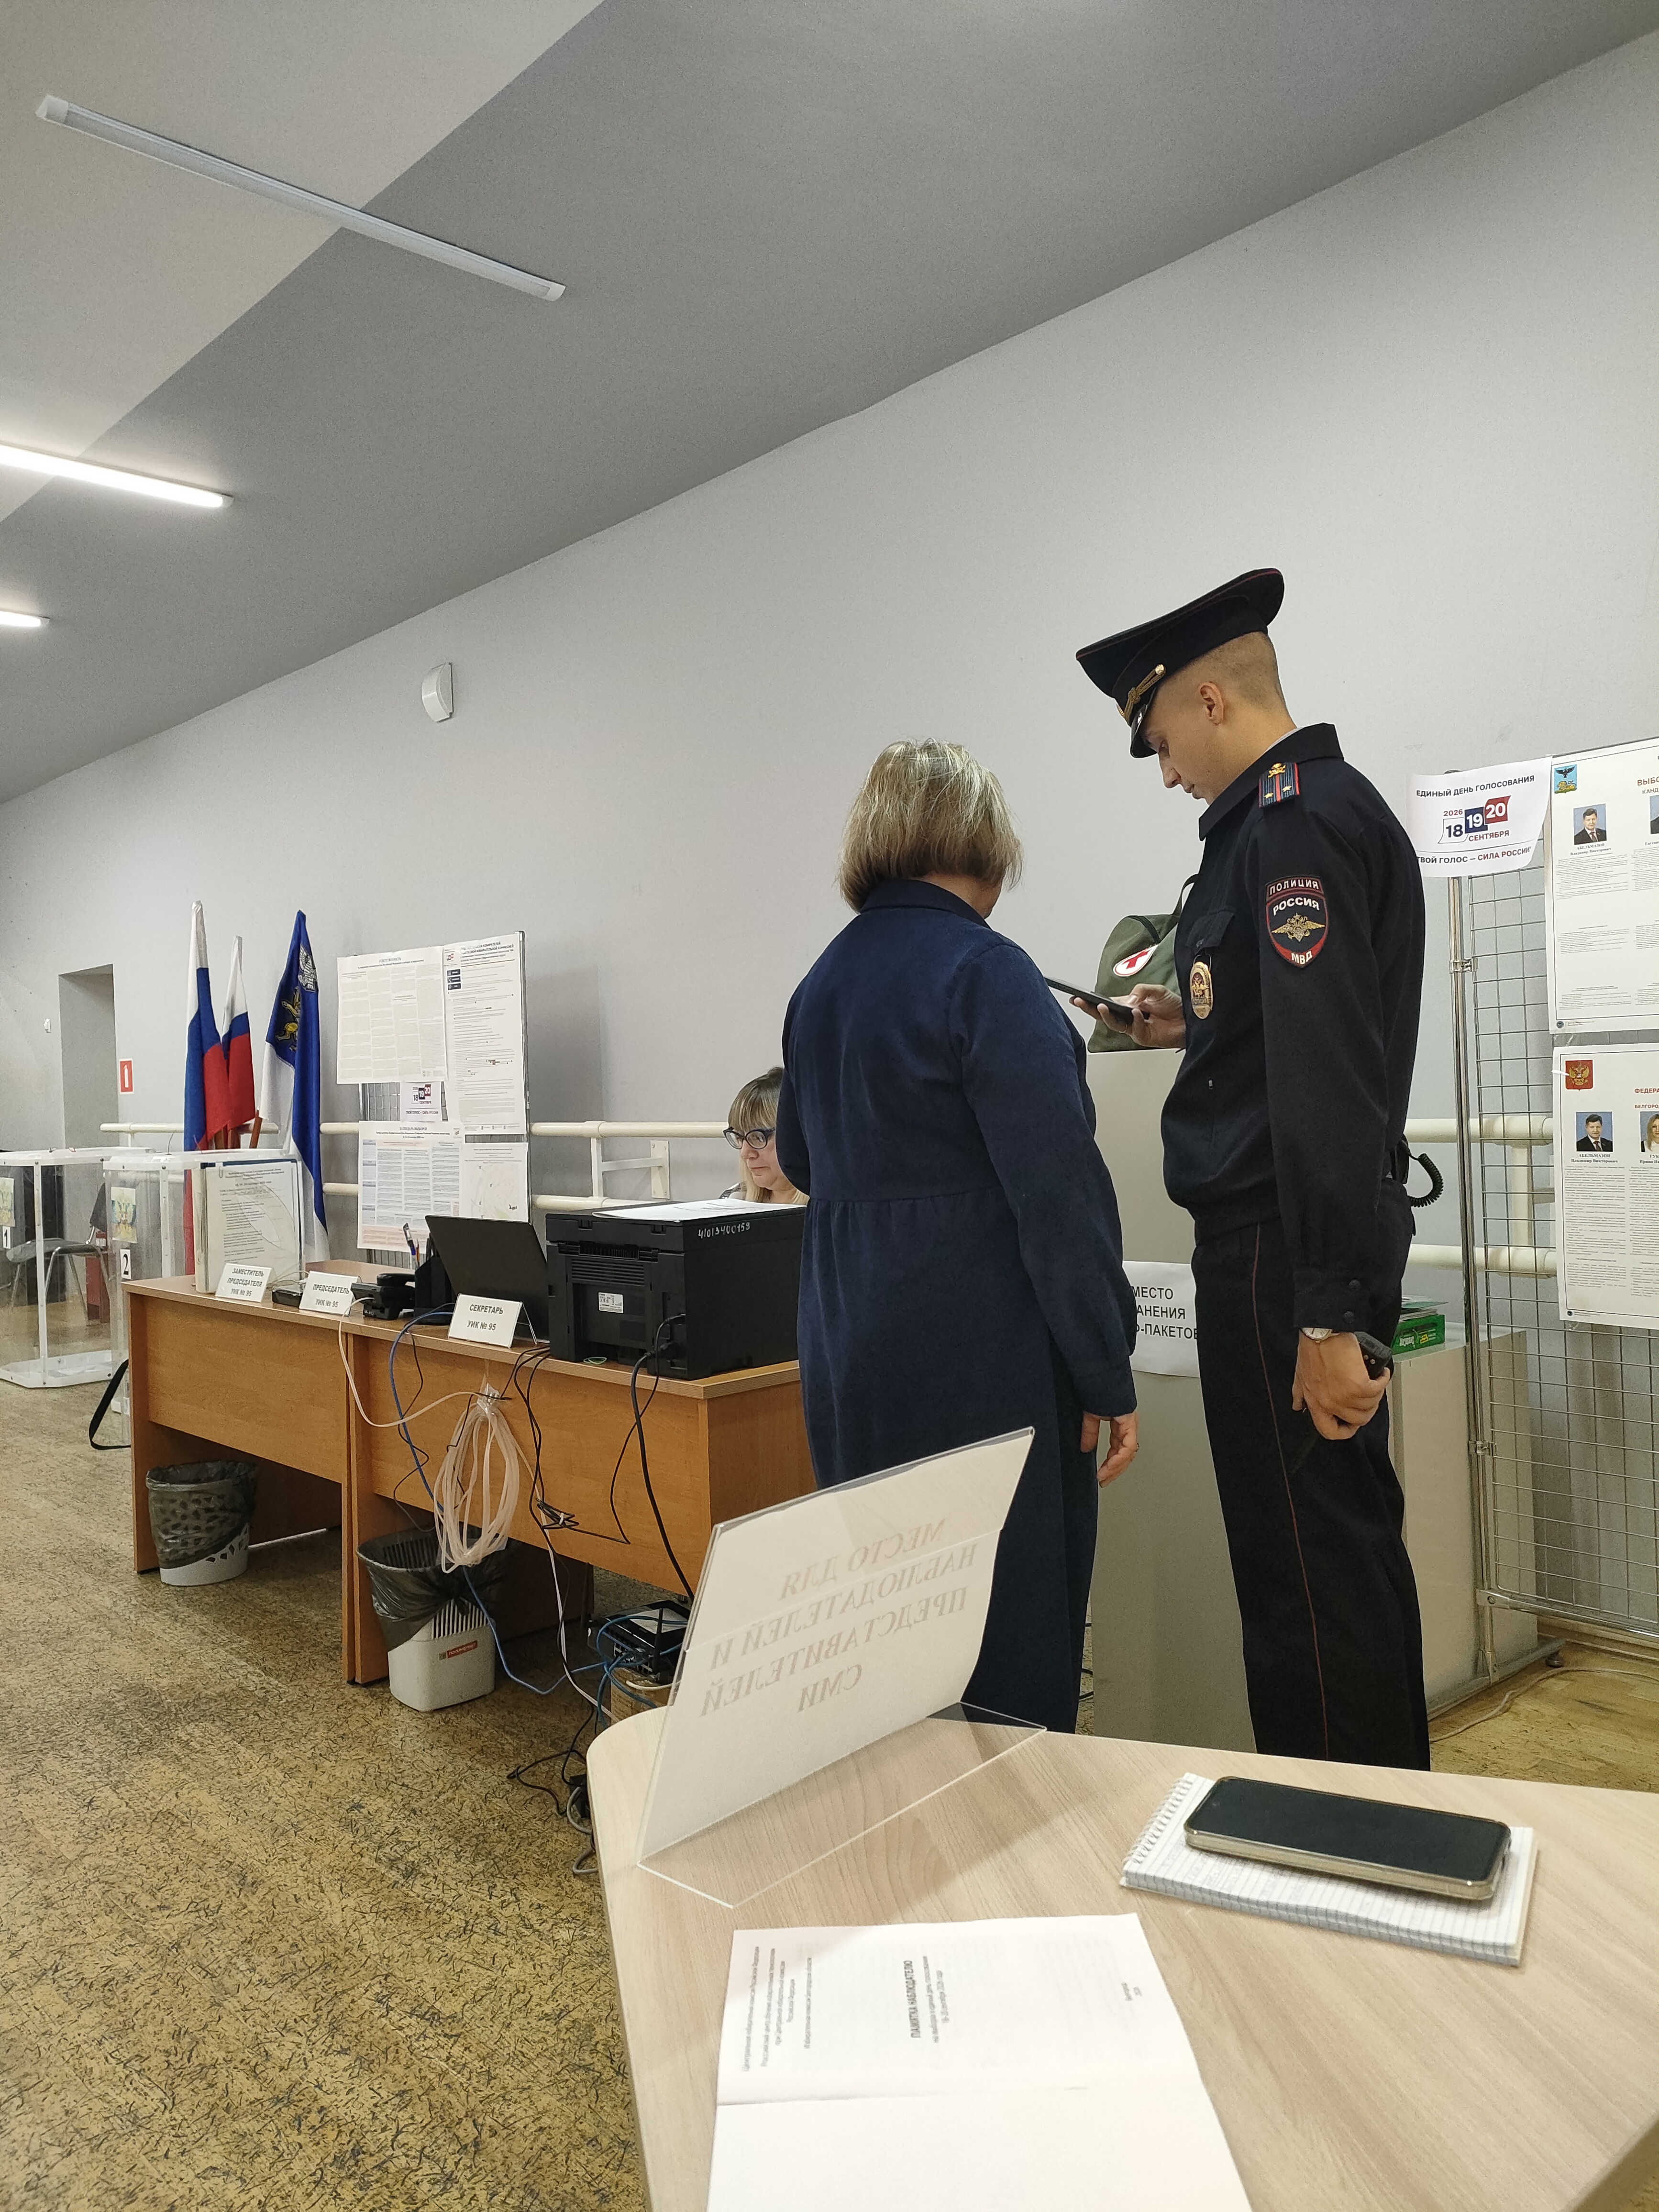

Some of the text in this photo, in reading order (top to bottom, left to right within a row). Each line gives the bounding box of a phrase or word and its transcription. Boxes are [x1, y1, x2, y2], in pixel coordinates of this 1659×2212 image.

[1416, 775, 1535, 797] ЕДИНЫЙ ДЕНЬ ГОЛОСОВАНИЯ
[1446, 802, 1506, 838] 18 19 20
[1469, 830, 1509, 842] СЕНТЯБРЯ
[1478, 852, 1500, 861] СИЛА
[1269, 879, 1319, 896] ПОЛИЦИЯ
[1273, 897, 1320, 916] РОССИЯ
[1291, 951, 1313, 965] МВД
[4, 1229, 8, 1247] 1
[123, 1253, 129, 1275] 2
[232, 1268, 264, 1277] ЗАМЕСТИТЕЛЬ
[227, 1278, 263, 1287] ПРЕДСЕДАТЕЛЯ
[312, 1284, 350, 1295] ПРЕДСЕДАТЕЛЬ
[1131, 1286, 1173, 1300] МЕСТО
[470, 1304, 503, 1315] СЕКРЕТАРЬ
[1137, 1305, 1185, 1320] АНЕНИЯ
[467, 1320, 479, 1328] УИК
